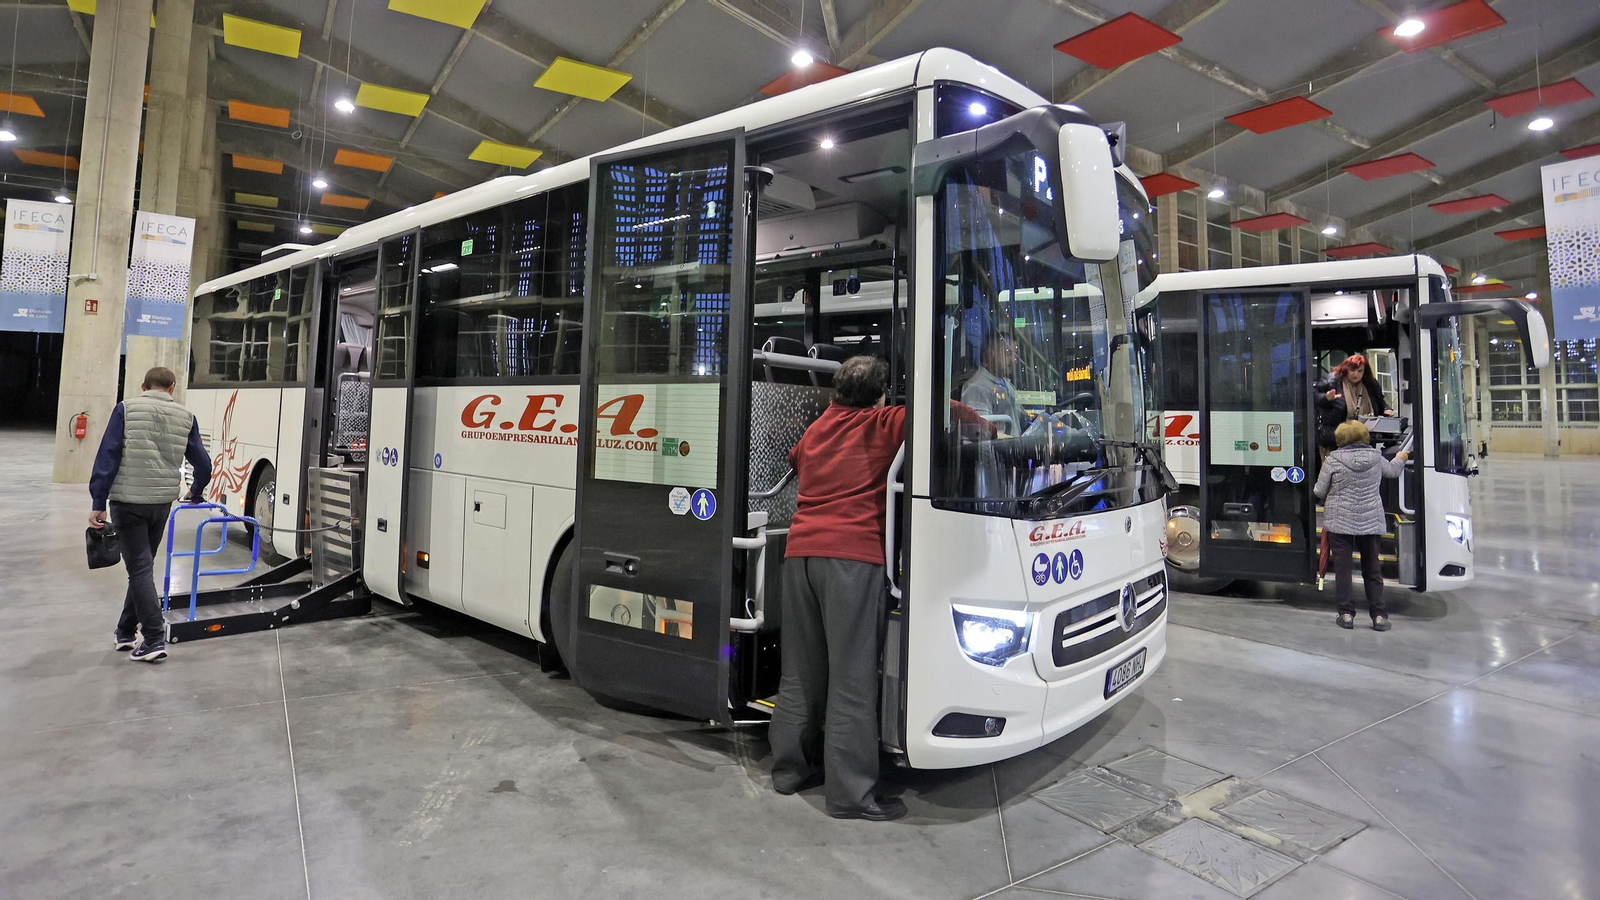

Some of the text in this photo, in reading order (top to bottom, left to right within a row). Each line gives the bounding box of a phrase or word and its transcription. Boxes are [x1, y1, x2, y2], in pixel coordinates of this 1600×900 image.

[13, 210, 65, 224] IFECA
[141, 221, 188, 237] IFECA
[1029, 520, 1085, 541] G.E.A.
[1112, 661, 1132, 687] 4086
